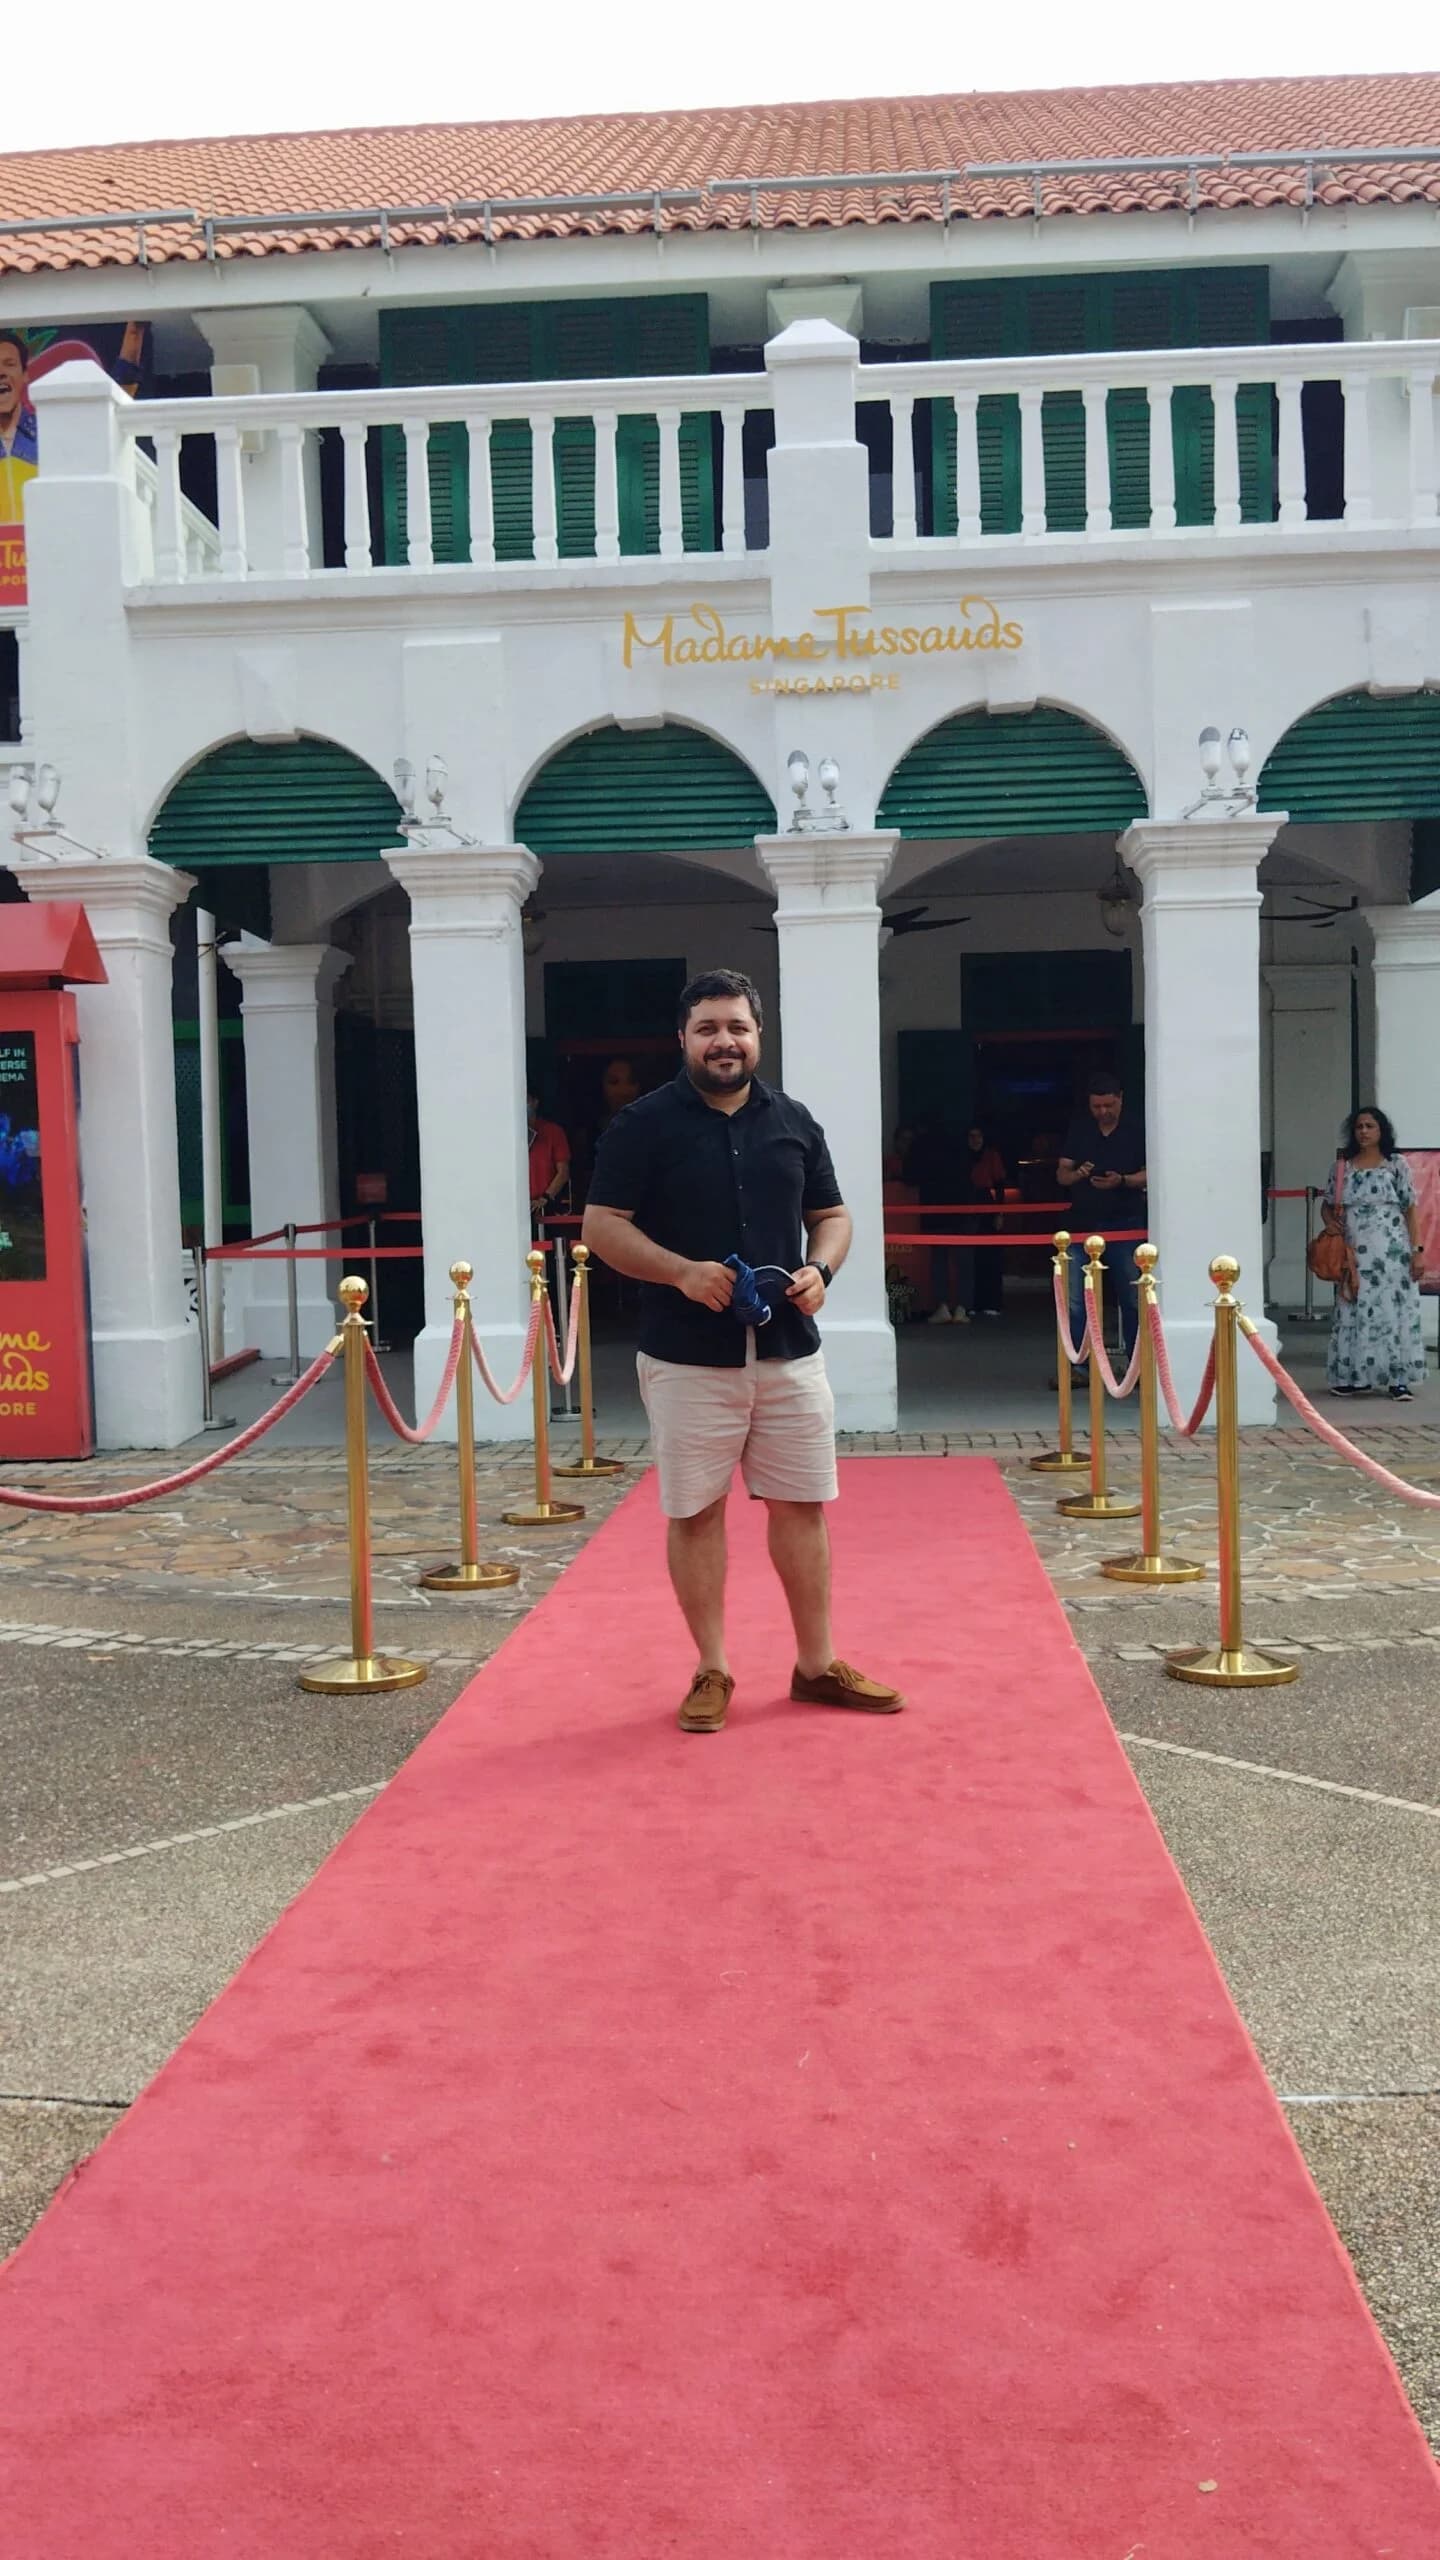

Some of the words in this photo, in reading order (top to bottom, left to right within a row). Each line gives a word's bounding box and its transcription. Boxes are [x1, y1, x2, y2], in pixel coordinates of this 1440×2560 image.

[623, 602, 829, 668] Madame
[814, 595, 1023, 658] Tussauds
[750, 673, 899, 694] SINGAPORE
[13, 1048, 26, 1057] IN
[0, 1402, 37, 1415] ORE
